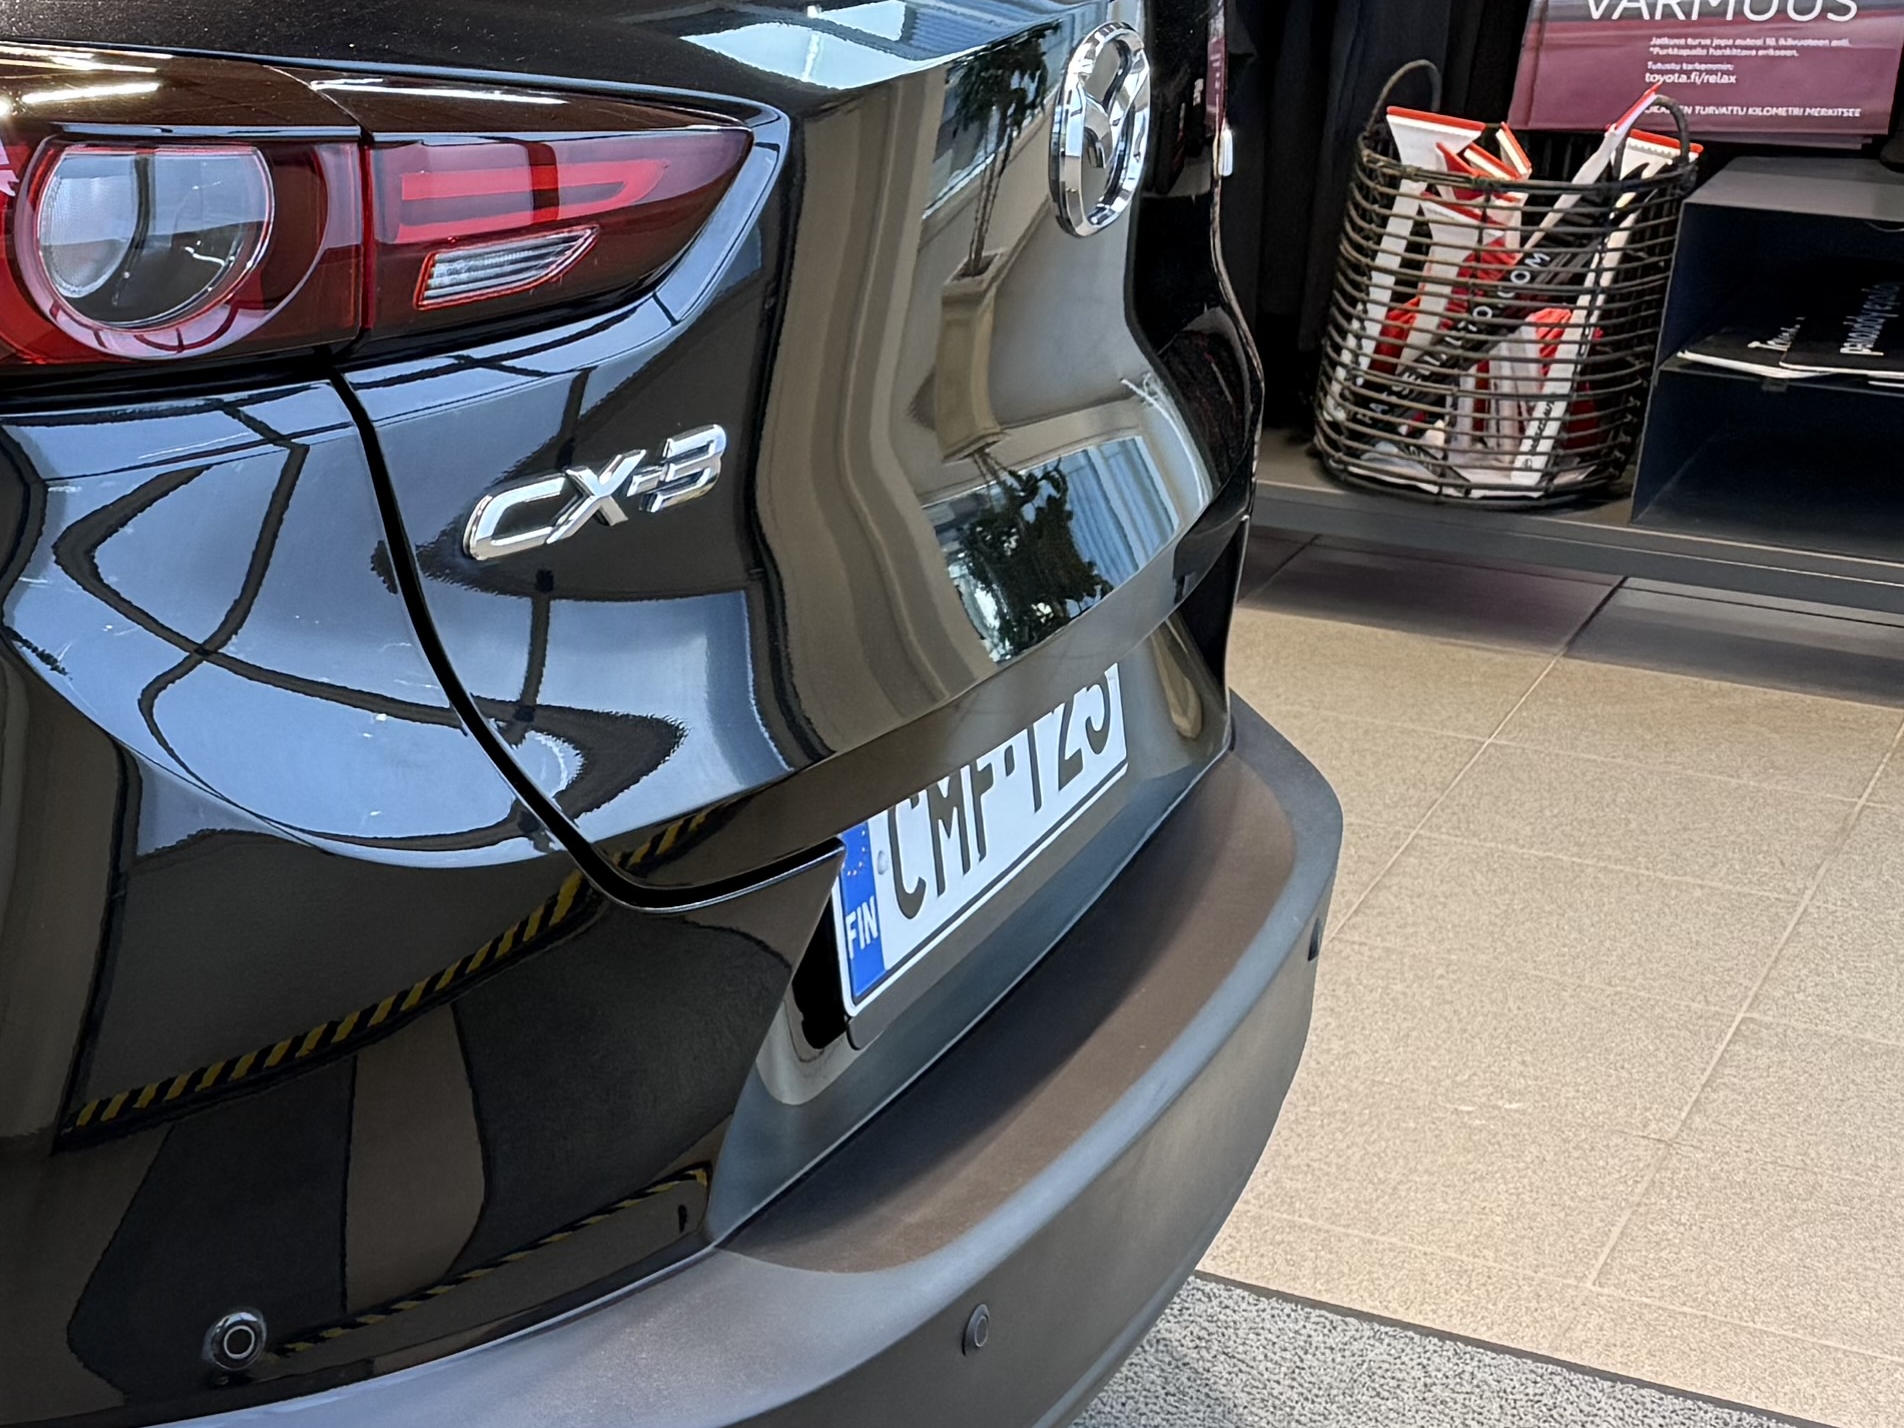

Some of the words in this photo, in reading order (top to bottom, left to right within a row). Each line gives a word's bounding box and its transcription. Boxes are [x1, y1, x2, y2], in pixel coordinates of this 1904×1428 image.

[1645, 71, 1737, 85] toyota.fi/relax
[461, 423, 728, 561] CX-3
[844, 895, 880, 961] FIN
